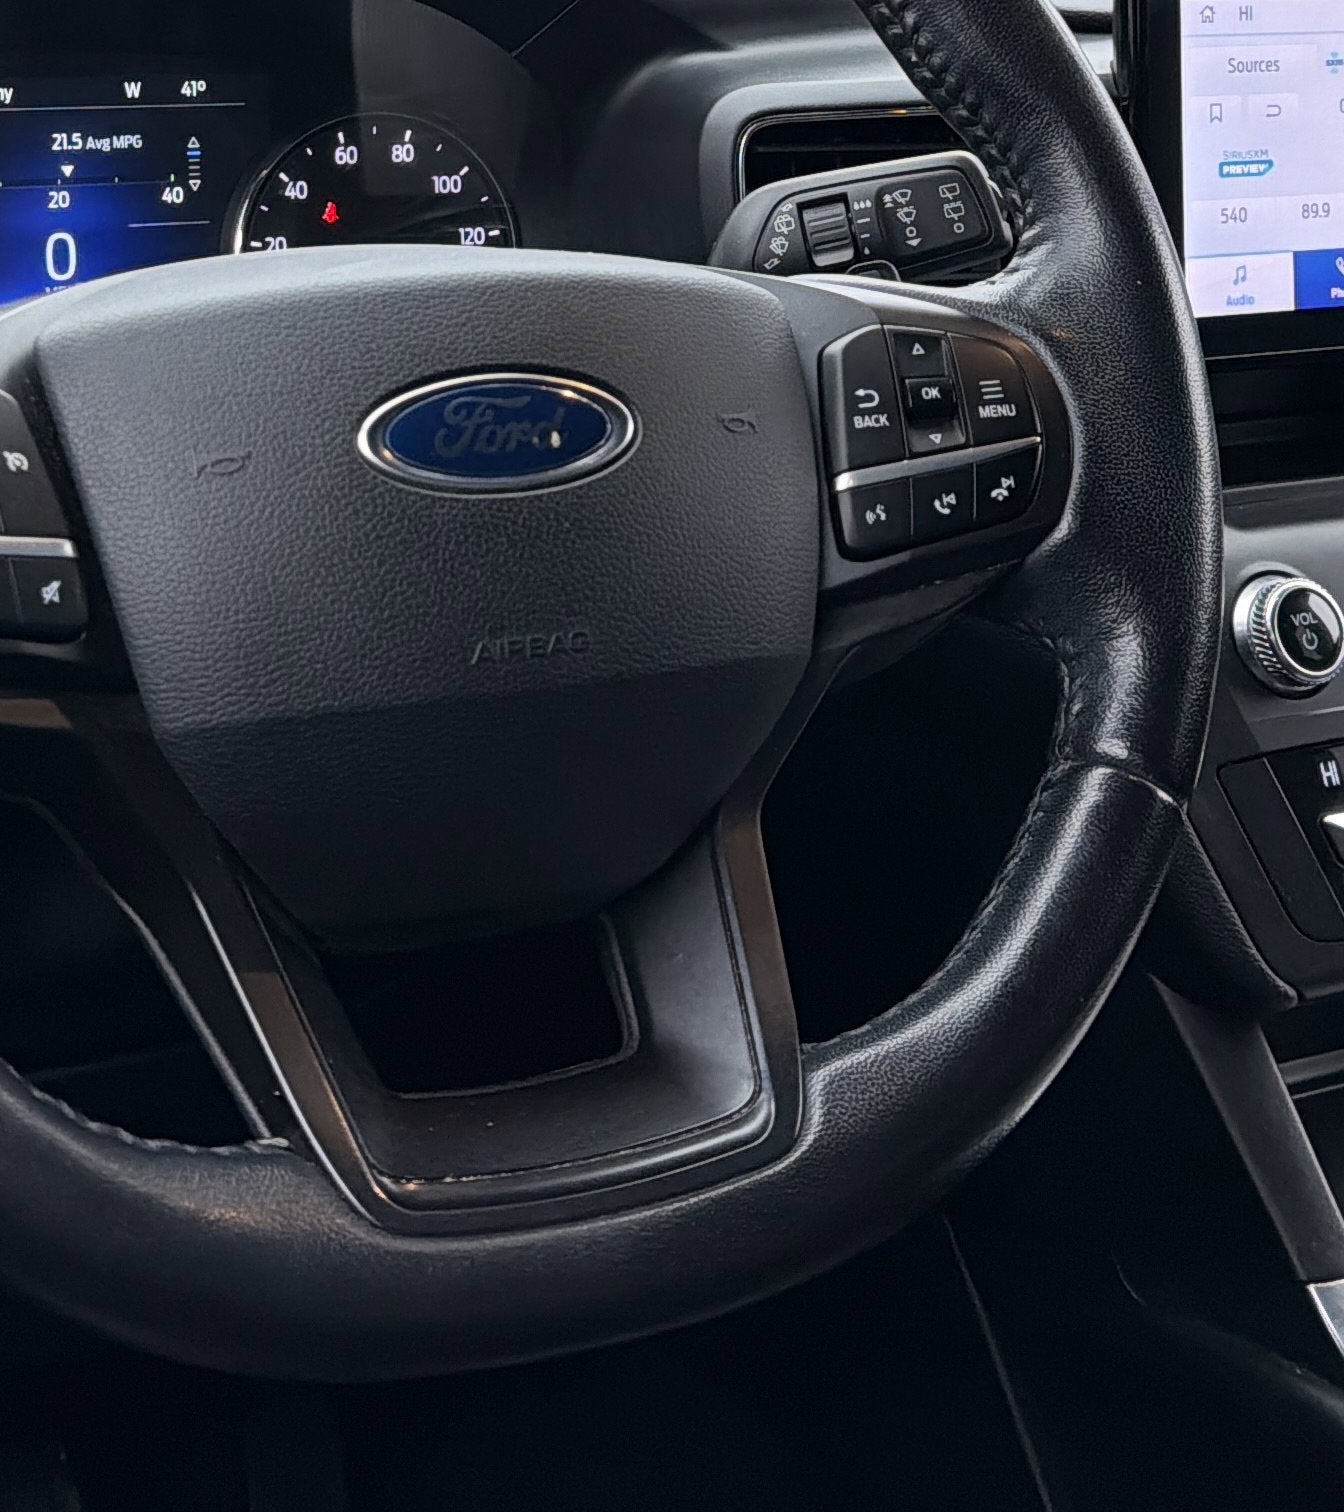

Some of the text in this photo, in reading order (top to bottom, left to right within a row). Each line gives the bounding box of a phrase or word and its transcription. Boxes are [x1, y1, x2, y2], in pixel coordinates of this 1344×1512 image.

[1239, 5, 1253, 21] HI
[1228, 57, 1280, 73] Sources
[124, 81, 142, 99] W
[51, 133, 143, 152] 21.5 Avg MPG
[334, 146, 357, 165] 60
[391, 144, 415, 163] 80
[284, 180, 308, 200] 40
[431, 175, 462, 194] 100
[47, 191, 70, 209] 20
[161, 186, 184, 204] 40
[1221, 206, 1248, 224] 540
[1301, 202, 1330, 219] 89.9
[264, 236, 288, 252] 20
[459, 226, 485, 246] 120
[45, 232, 77, 281] 0
[1226, 293, 1256, 306] Audio
[921, 386, 942, 400] OK
[853, 413, 891, 429] BACK
[978, 404, 1017, 420] MENU
[434, 394, 565, 458] Ford
[1290, 612, 1318, 628] VOL
[471, 630, 591, 665] AIRBAG
[1319, 759, 1341, 787] HI
